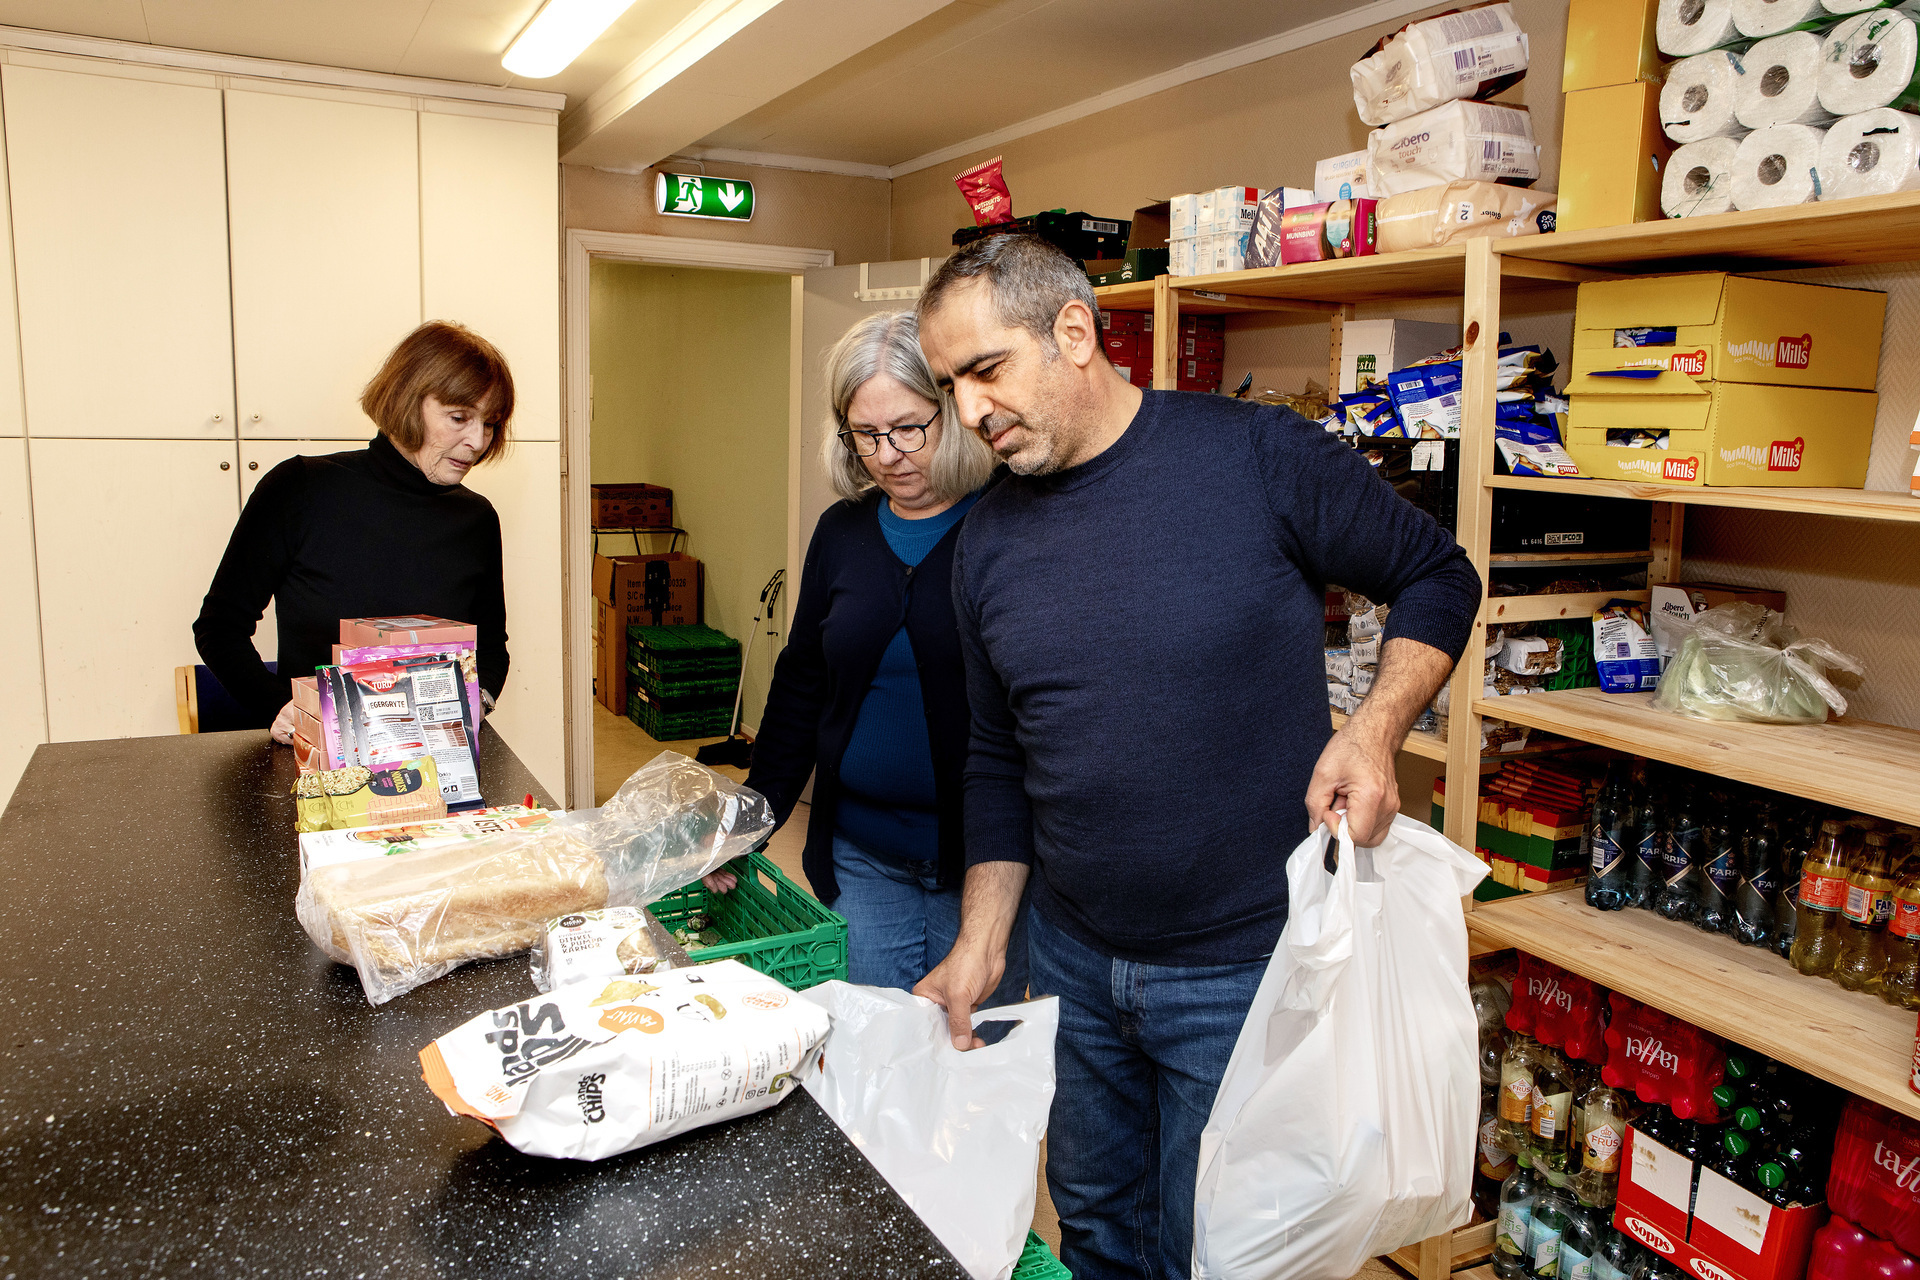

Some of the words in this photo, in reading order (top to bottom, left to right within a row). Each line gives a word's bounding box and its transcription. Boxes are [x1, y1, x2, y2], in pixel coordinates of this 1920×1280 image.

[1332, 158, 1362, 172] SURGICAL
[1240, 208, 1256, 220] Meli
[1286, 229, 1316, 241] MUNNBIND
[1342, 240, 1350, 248] 50
[1778, 341, 1808, 365] Mills
[1673, 356, 1704, 373] Mills
[1770, 445, 1800, 467] Mills
[1665, 461, 1695, 479] Mills
[627, 578, 642, 588] Item
[1661, 601, 1686, 612] Libero
[371, 680, 393, 691] TORO
[367, 700, 406, 710] JEGERGRYTE
[1709, 867, 1740, 877] FARR
[1528, 977, 1572, 1014] taffel
[1626, 1036, 1679, 1075] taffel
[1512, 1083, 1532, 1094] FRUS
[586, 1072, 606, 1124] CHIPS
[1591, 1135, 1619, 1147] FRUS
[1630, 1219, 1671, 1253] Sopps
